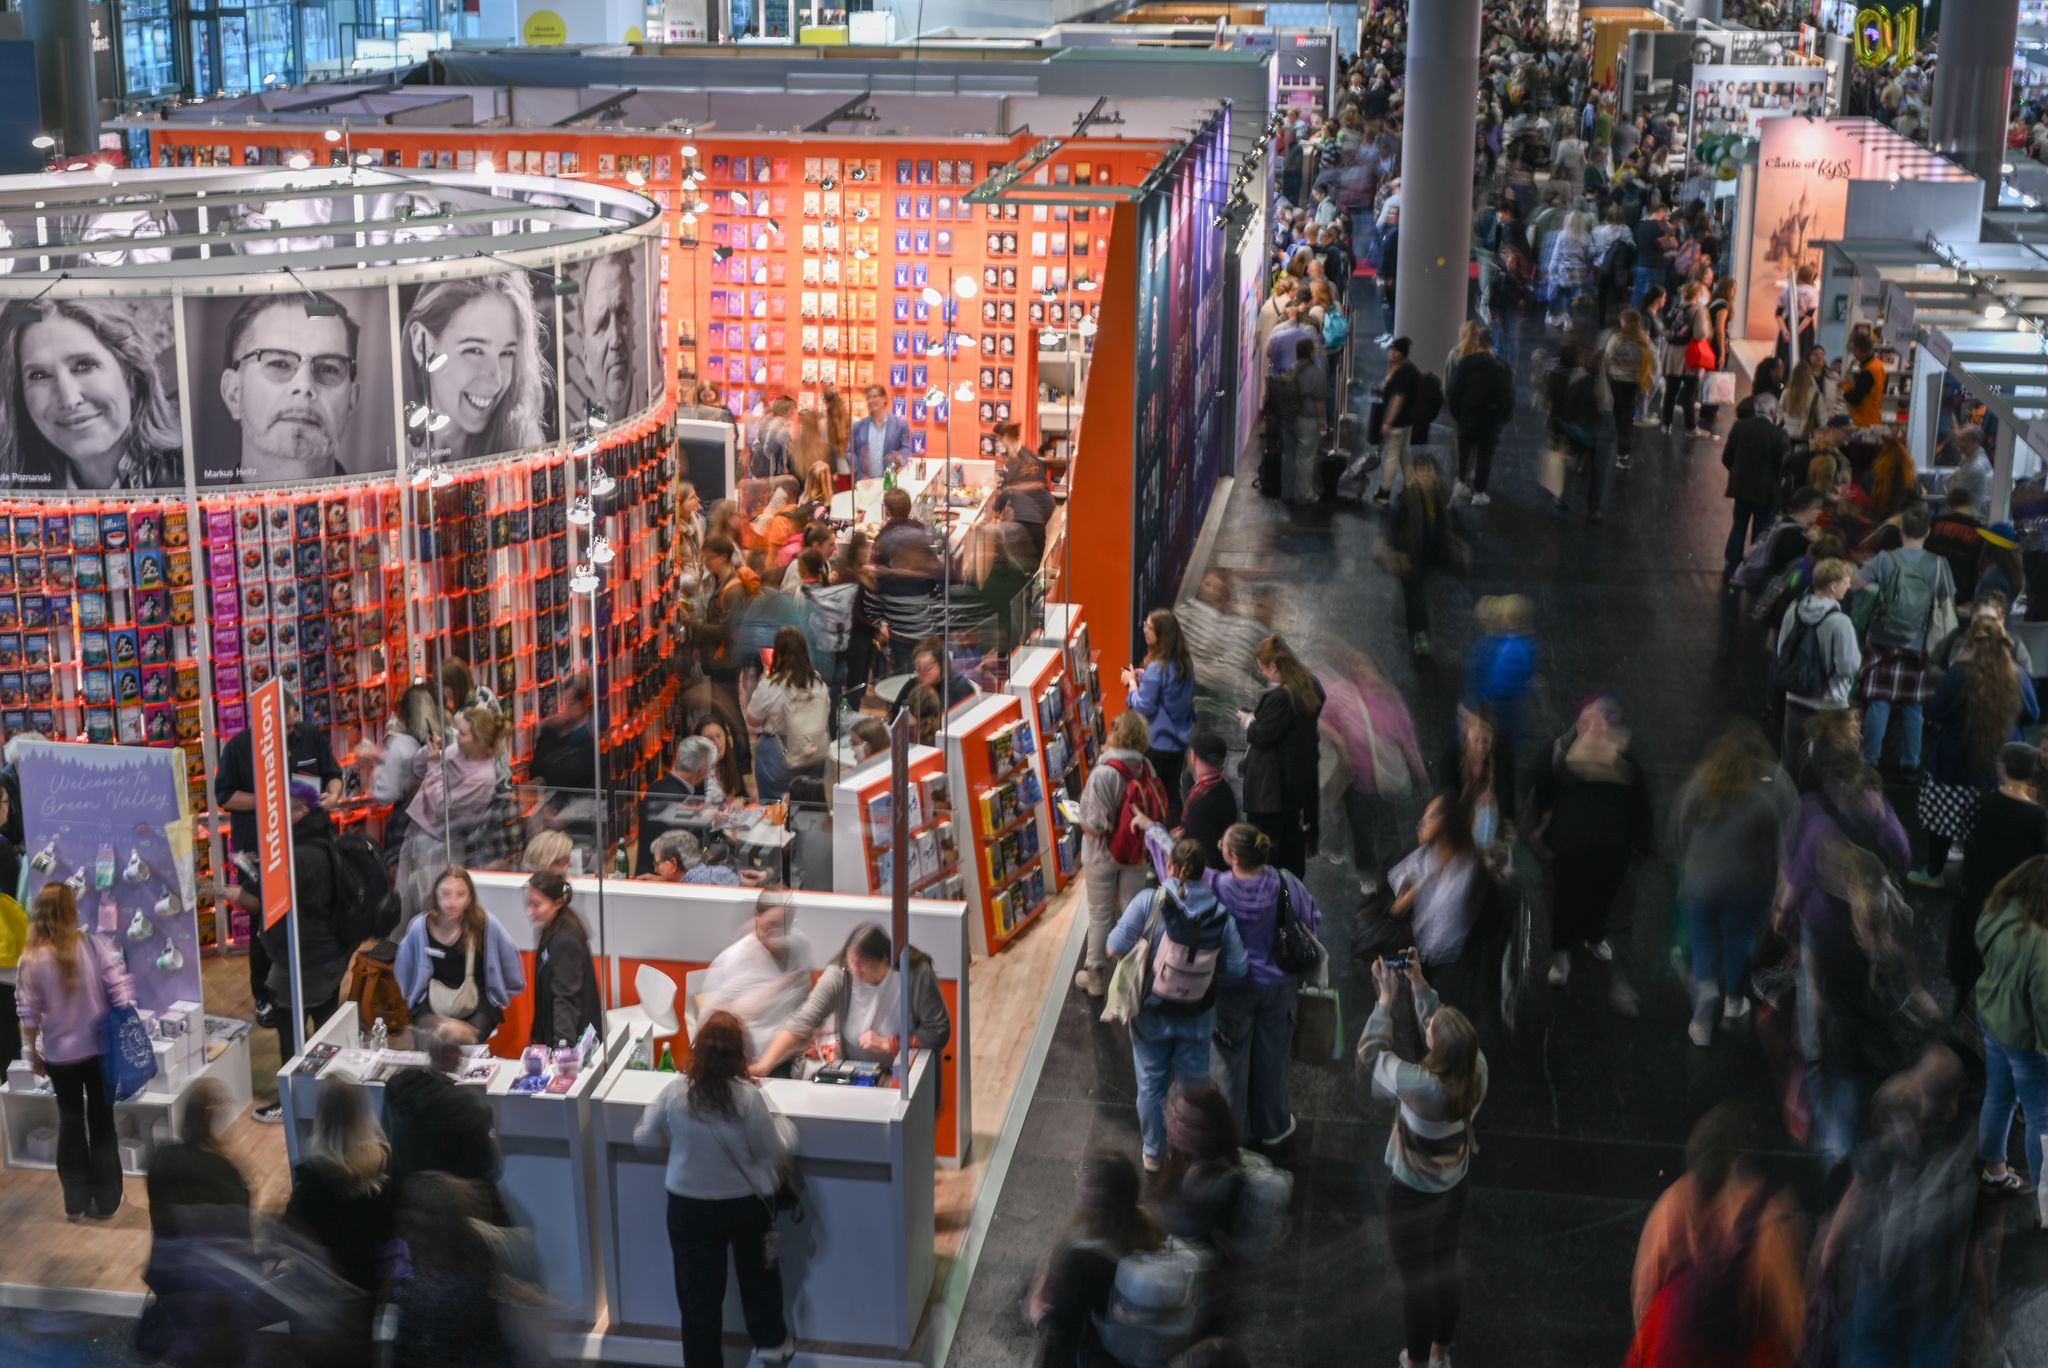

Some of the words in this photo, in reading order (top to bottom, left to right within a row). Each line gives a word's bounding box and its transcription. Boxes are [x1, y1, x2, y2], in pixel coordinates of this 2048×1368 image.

[1765, 157, 1800, 168] Castle
[12, 472, 52, 482] Poznanski
[204, 468, 234, 479] Markus
[50, 772, 131, 794] Welcome
[260, 693, 282, 873] Information
[40, 795, 101, 816] Green
[106, 788, 170, 811] Valley
